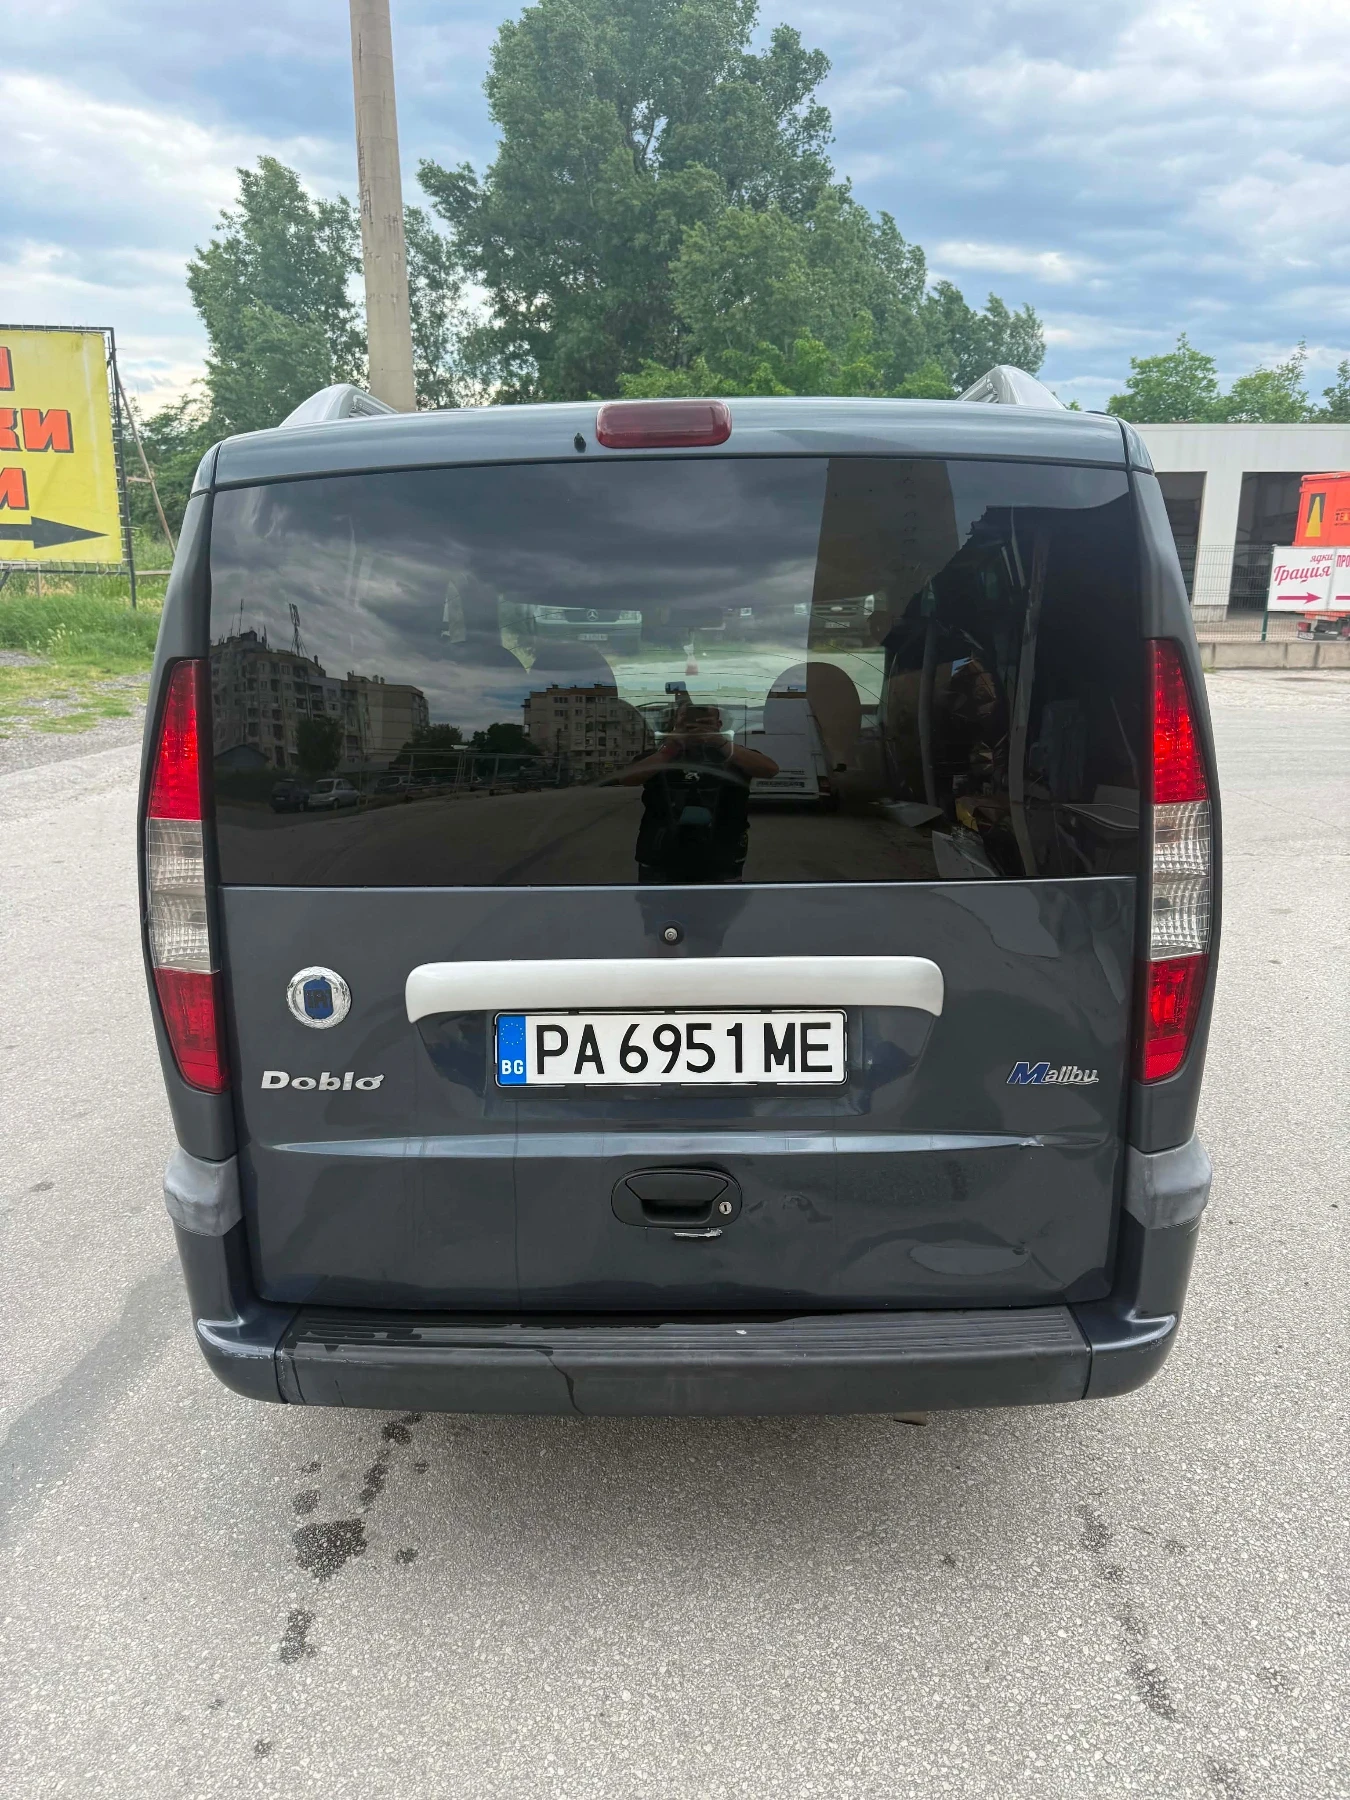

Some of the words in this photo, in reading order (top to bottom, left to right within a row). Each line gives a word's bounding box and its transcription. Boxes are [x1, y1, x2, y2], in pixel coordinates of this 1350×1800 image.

[1274, 564, 1331, 586] Грация
[536, 1023, 605, 1075] PA
[619, 1022, 743, 1074] 6951
[763, 1021, 833, 1073] ME
[501, 1059, 524, 1075] BG
[1006, 1061, 1100, 1085] Malibu
